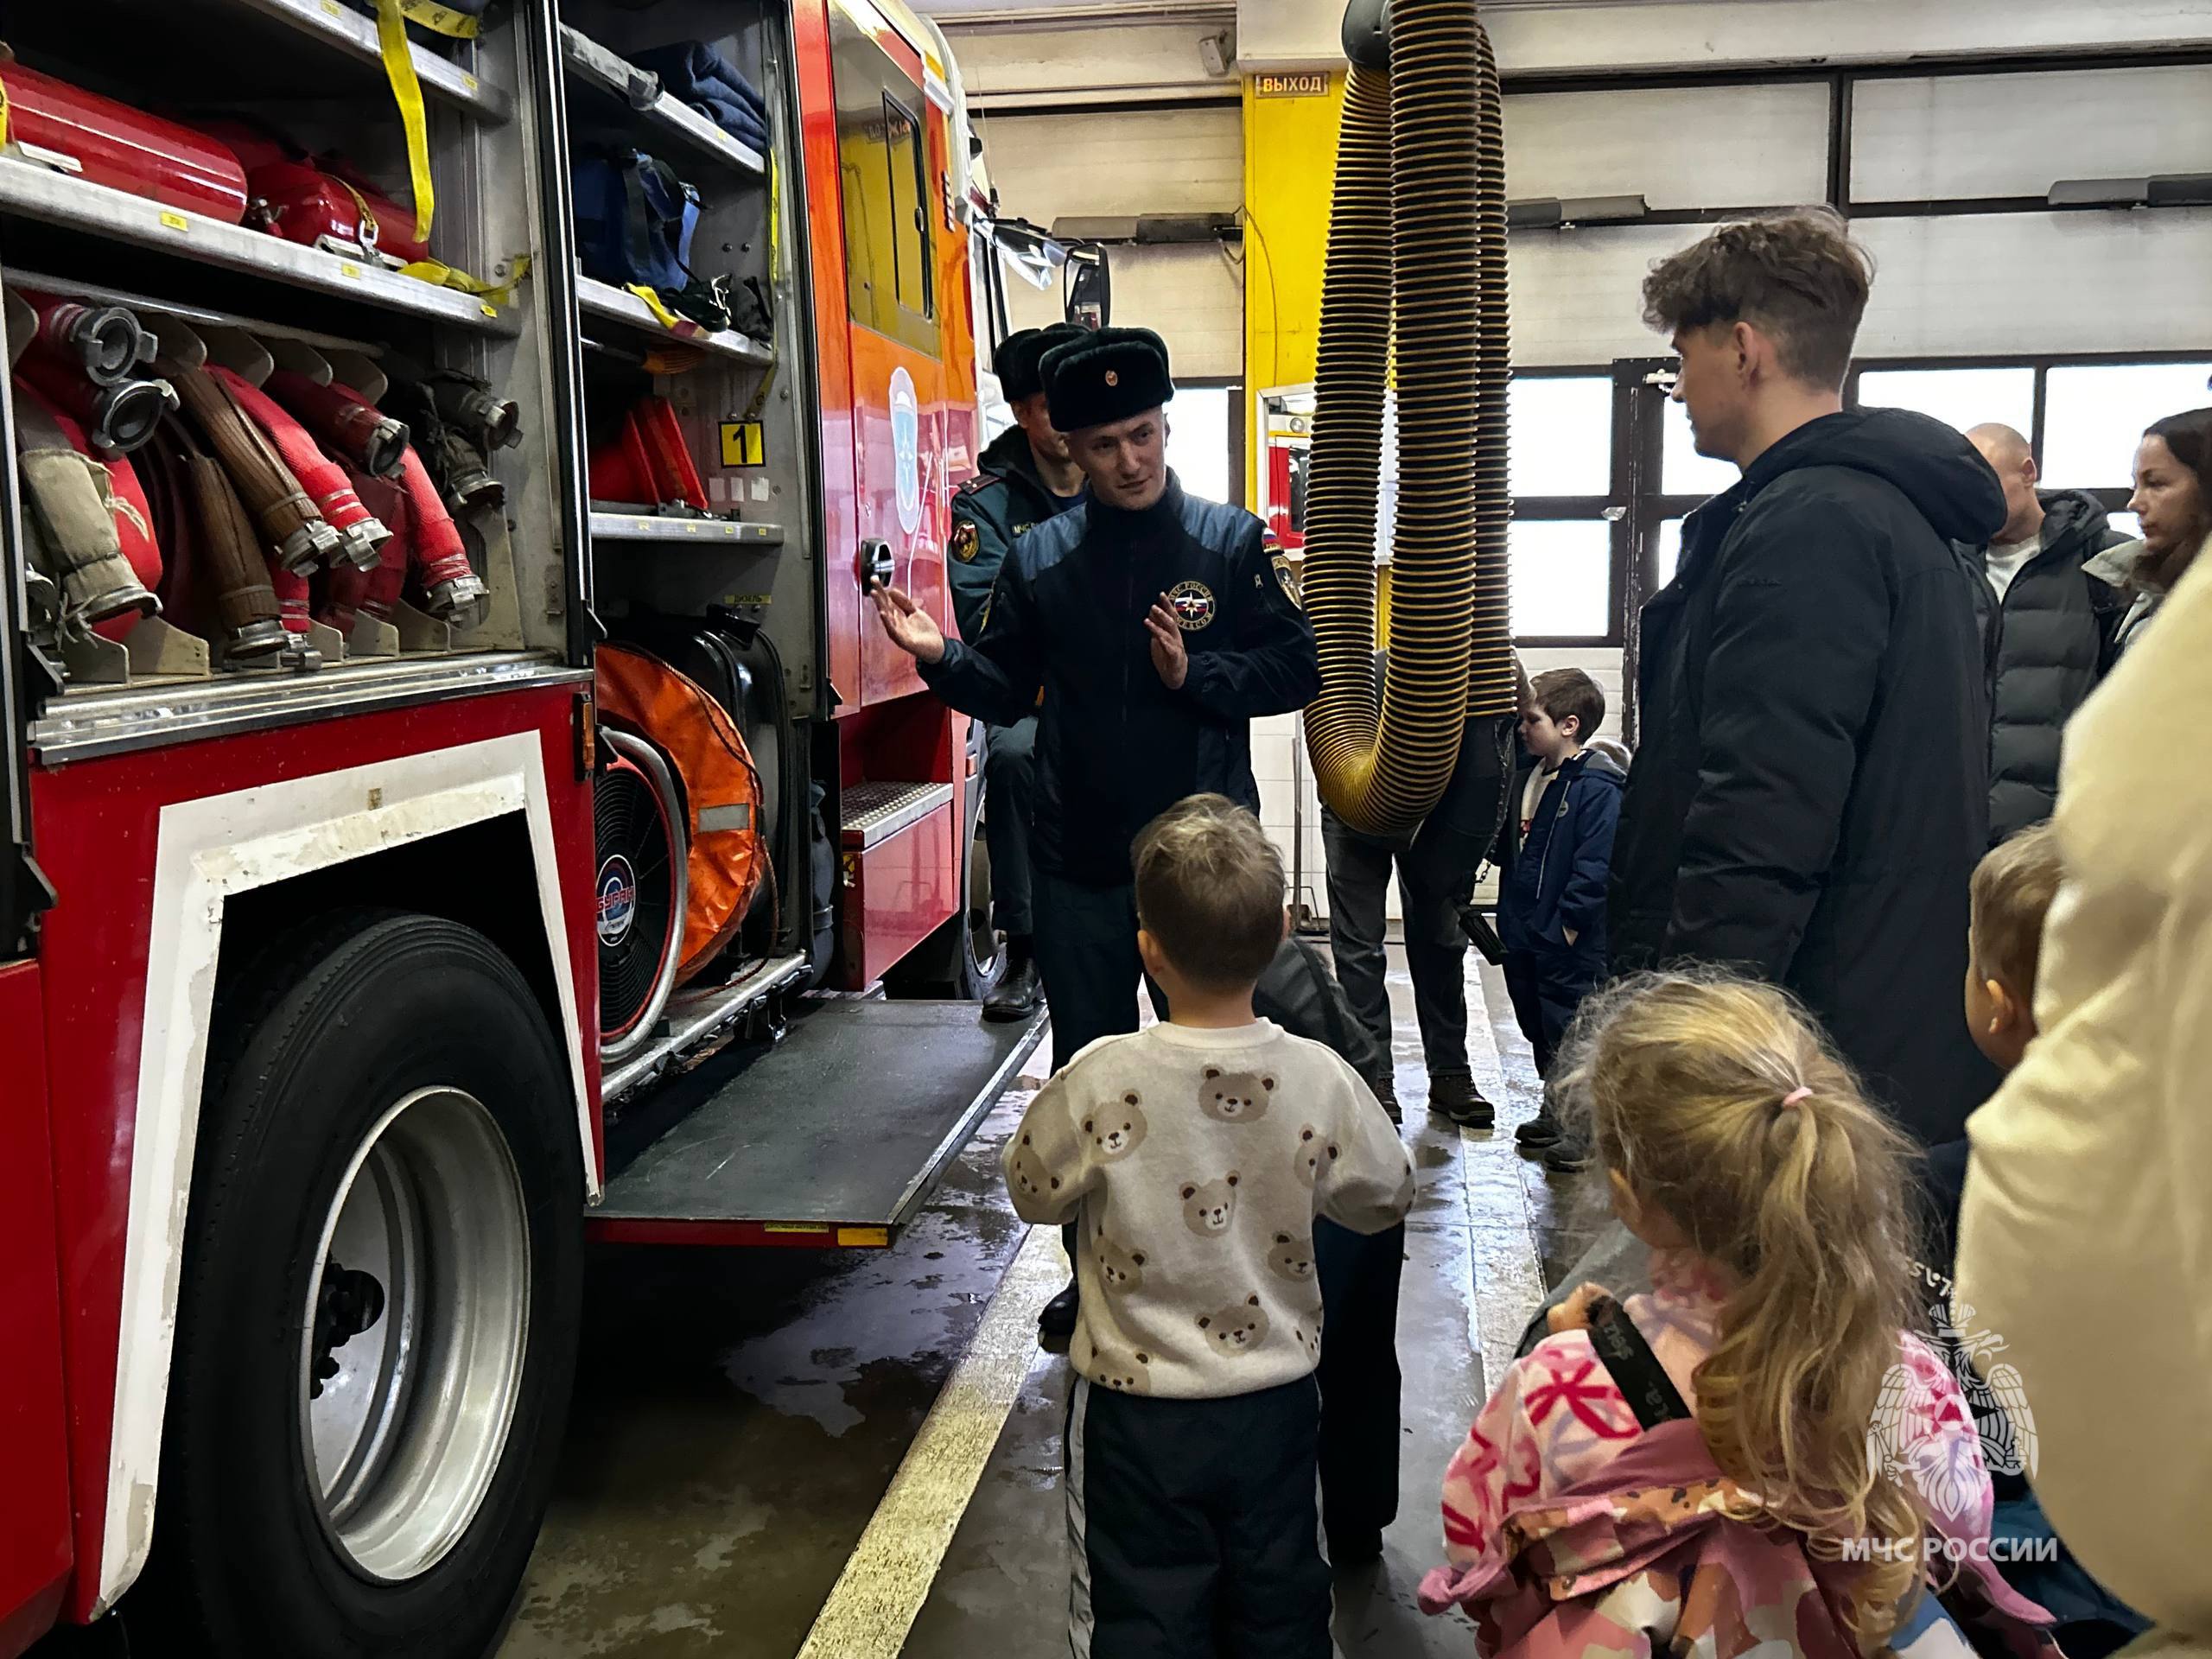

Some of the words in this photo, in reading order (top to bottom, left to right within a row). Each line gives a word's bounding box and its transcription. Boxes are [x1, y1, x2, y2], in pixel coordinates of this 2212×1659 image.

[1263, 76, 1322, 92] ВЫХОД
[733, 424, 747, 463] 1
[596, 886, 635, 914] БУРАН
